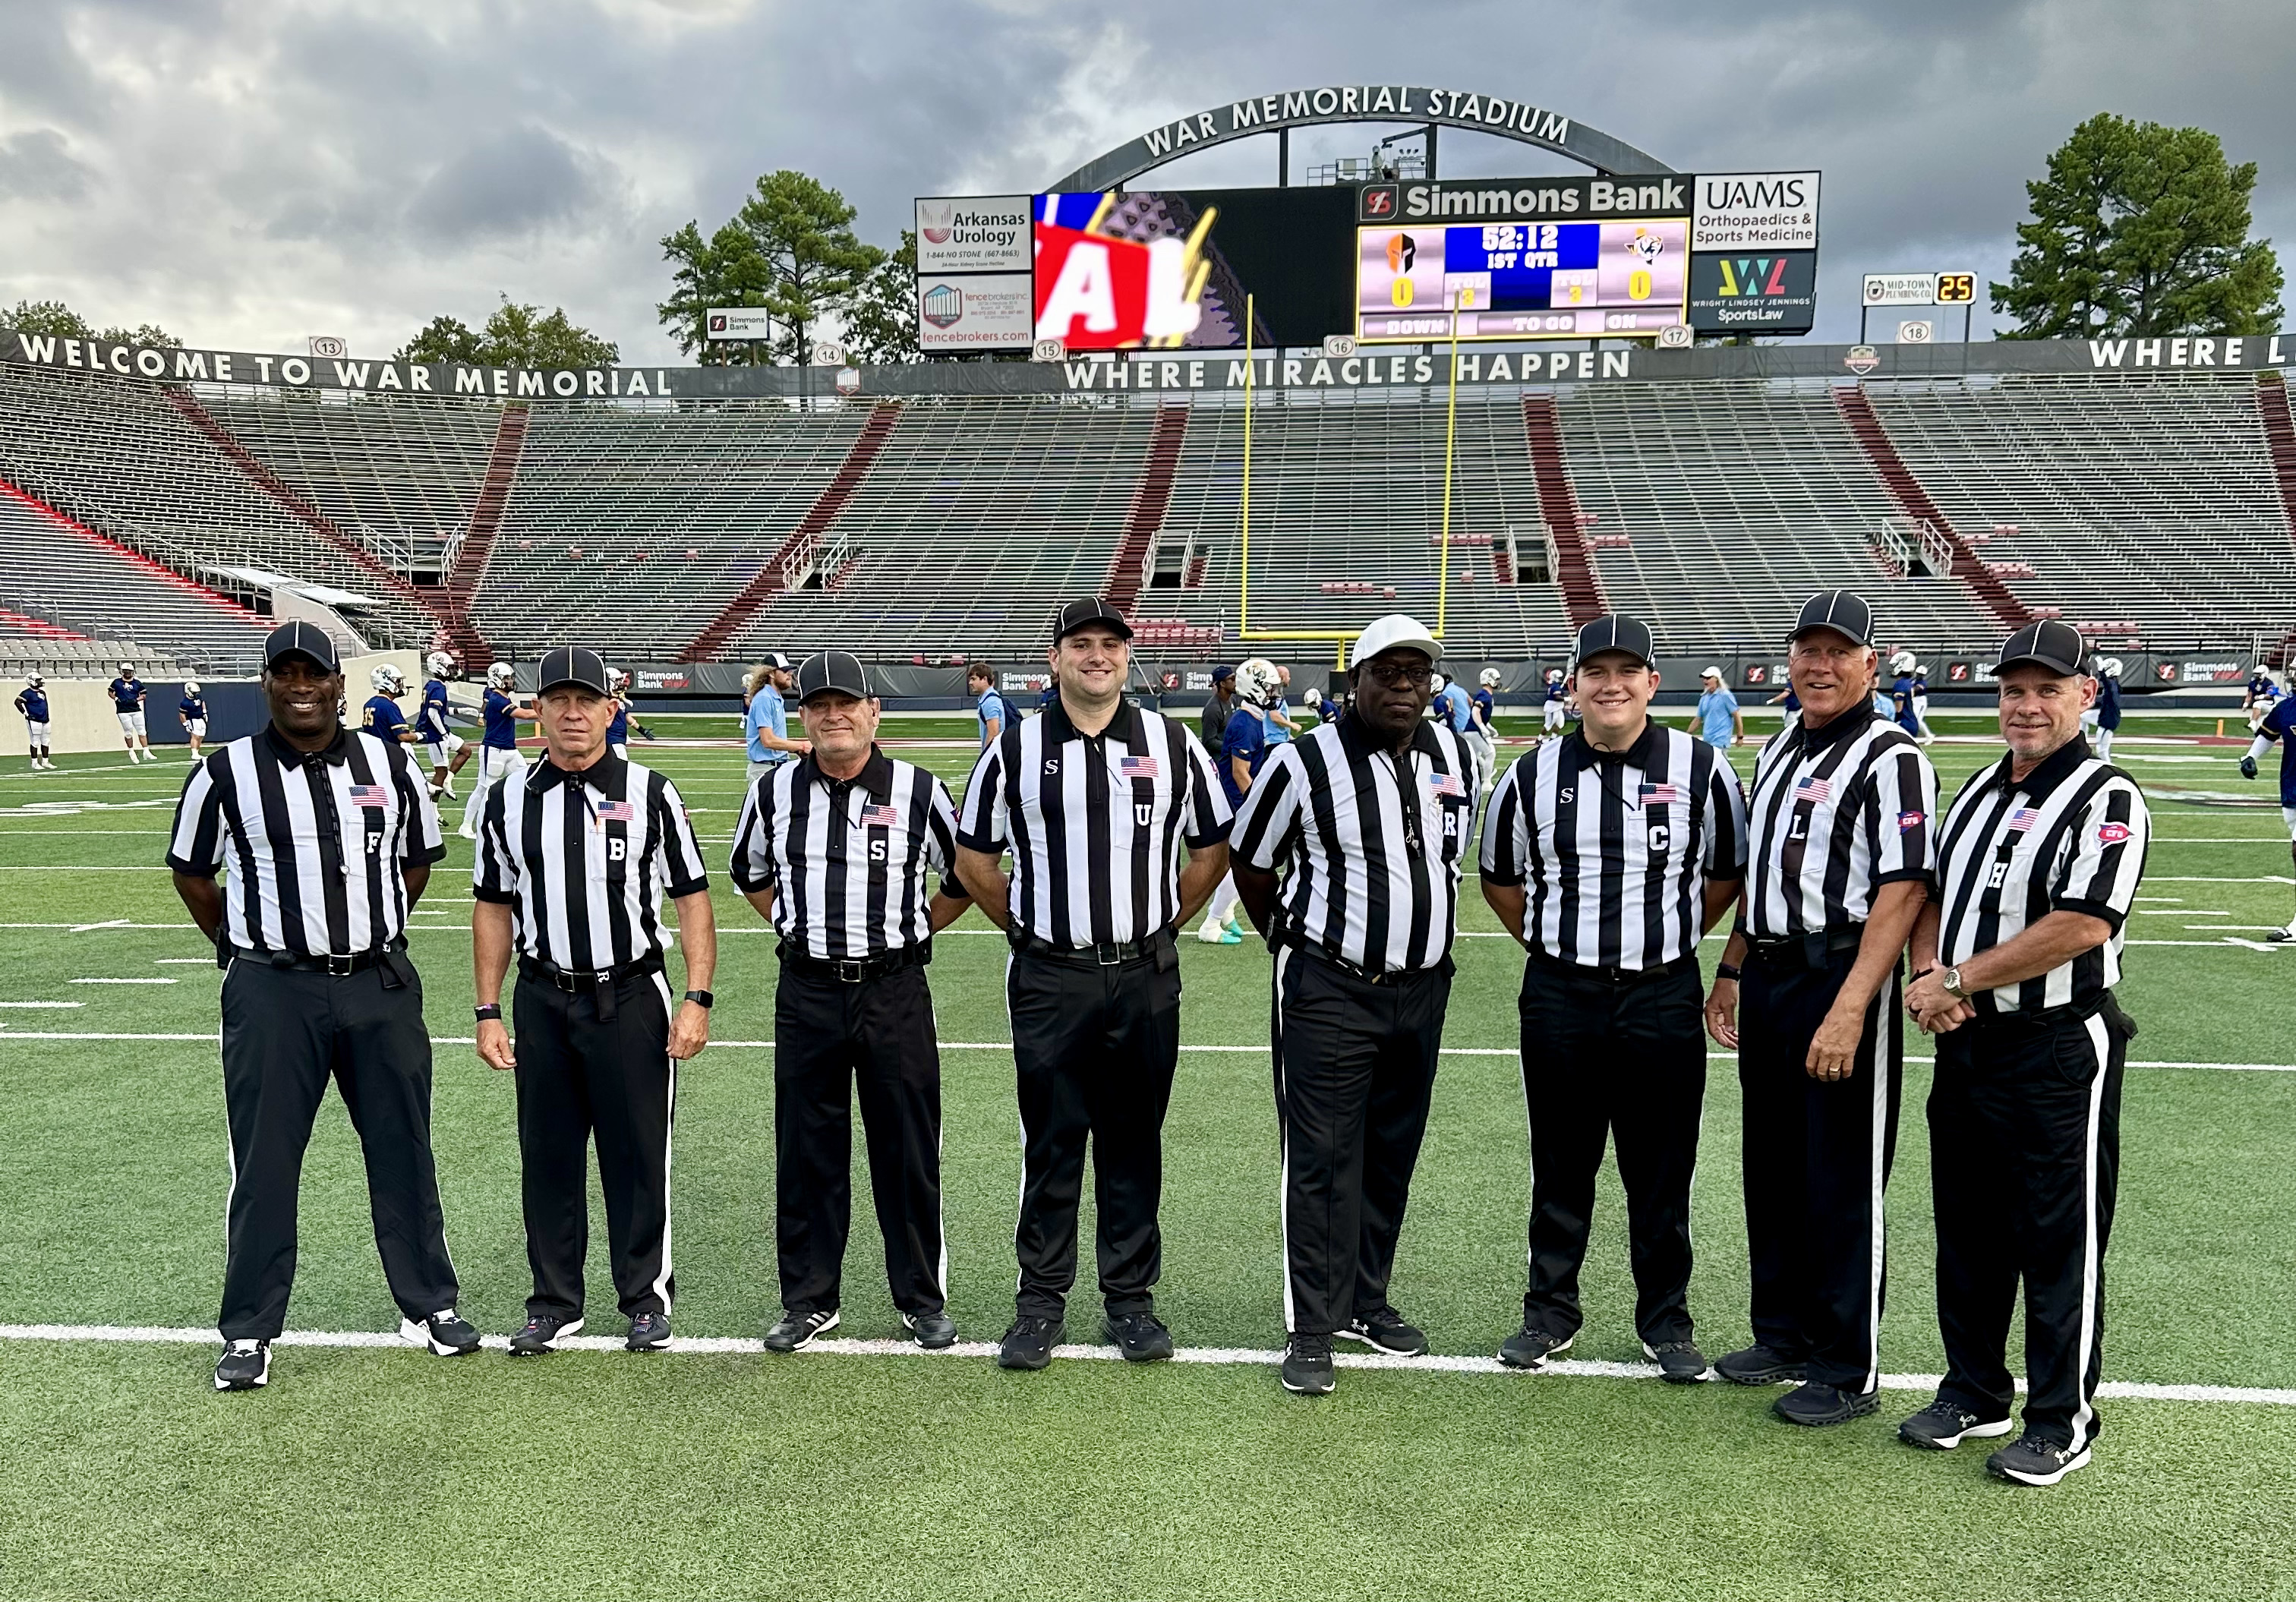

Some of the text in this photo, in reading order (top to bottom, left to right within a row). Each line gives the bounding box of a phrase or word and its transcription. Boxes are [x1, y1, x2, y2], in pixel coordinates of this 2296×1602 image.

[1143, 87, 1569, 157] WAR MEMORIAL STADIUM
[1406, 178, 1686, 217] Simmons Bank
[1707, 180, 1804, 210] UAMS
[953, 212, 1025, 226] Arkansas
[1699, 213, 1812, 228] Orthopaedics &
[953, 229, 1016, 246] Urology
[1482, 225, 1559, 251] 52:12
[1696, 229, 1813, 244] Sports Medicine
[1487, 251, 1559, 269] 1ST QTR
[1391, 277, 1414, 307] 0
[1629, 270, 1652, 301] 0
[1886, 280, 1932, 289] MID-TOWN
[1940, 276, 1970, 300] 25
[1462, 289, 1474, 305] 3
[1569, 286, 1582, 303] 3
[1768, 298, 1811, 306] JENNINGS
[1512, 316, 1573, 331] TO GO
[1717, 307, 1784, 324] SportsLaw
[1386, 320, 1445, 335] DOWN
[1668, 330, 1683, 342] 17
[1908, 328, 1922, 339] 18
[923, 331, 1029, 342] fencebrokers.com
[321, 343, 336, 354] 13
[822, 350, 834, 361] 14
[1041, 345, 1055, 357] 15
[1334, 342, 1348, 353] 16
[2088, 336, 2296, 367] WHERE L
[17, 333, 672, 396] WELCOME TO WAR MEMORIAL
[1063, 351, 1631, 389] WHERE MIRACLES HAPPEN
[638, 670, 684, 680] Simmons
[2183, 661, 2238, 672] Simmons
[638, 680, 663, 689] Bank
[2182, 671, 2213, 682] Bank
[1001, 682, 1028, 690] Bank
[362, 707, 377, 727] 35
[1135, 804, 1151, 827] U
[1443, 812, 1457, 836] R
[1789, 815, 1806, 840] L
[367, 831, 382, 853] F
[1649, 825, 1669, 851] C
[609, 837, 626, 861] B
[870, 840, 886, 861] S
[1986, 862, 2010, 889] H
